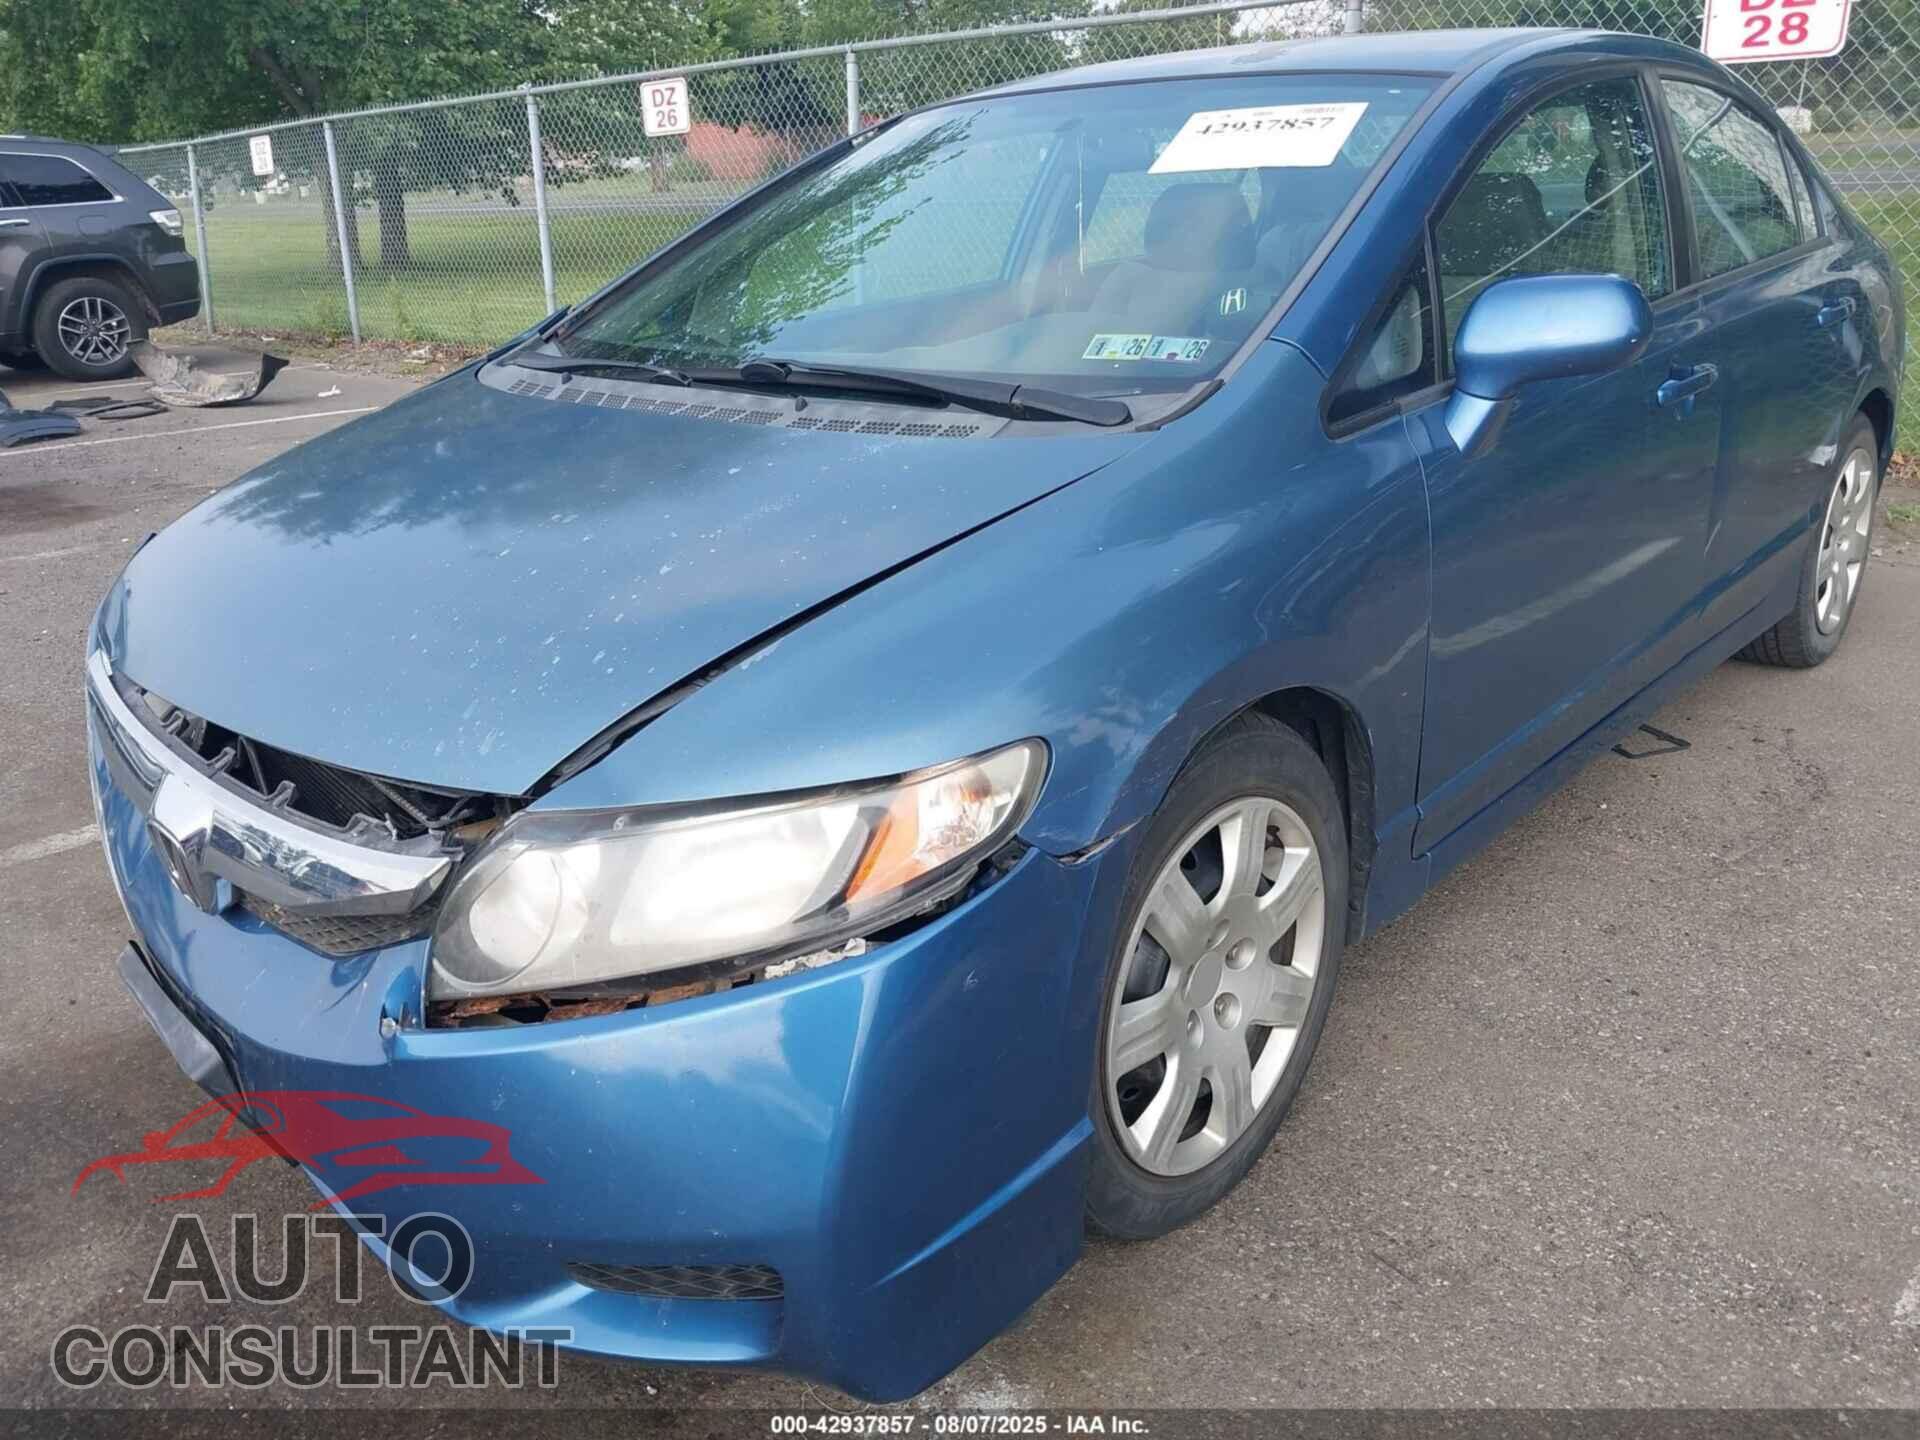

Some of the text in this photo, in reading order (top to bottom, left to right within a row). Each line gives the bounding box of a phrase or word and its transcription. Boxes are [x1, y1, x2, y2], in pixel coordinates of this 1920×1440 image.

[1742, 12, 1809, 48] 28
[652, 87, 678, 107] DZ
[656, 109, 677, 128] 26
[1126, 338, 1146, 356] 26
[1185, 340, 1207, 359] 26
